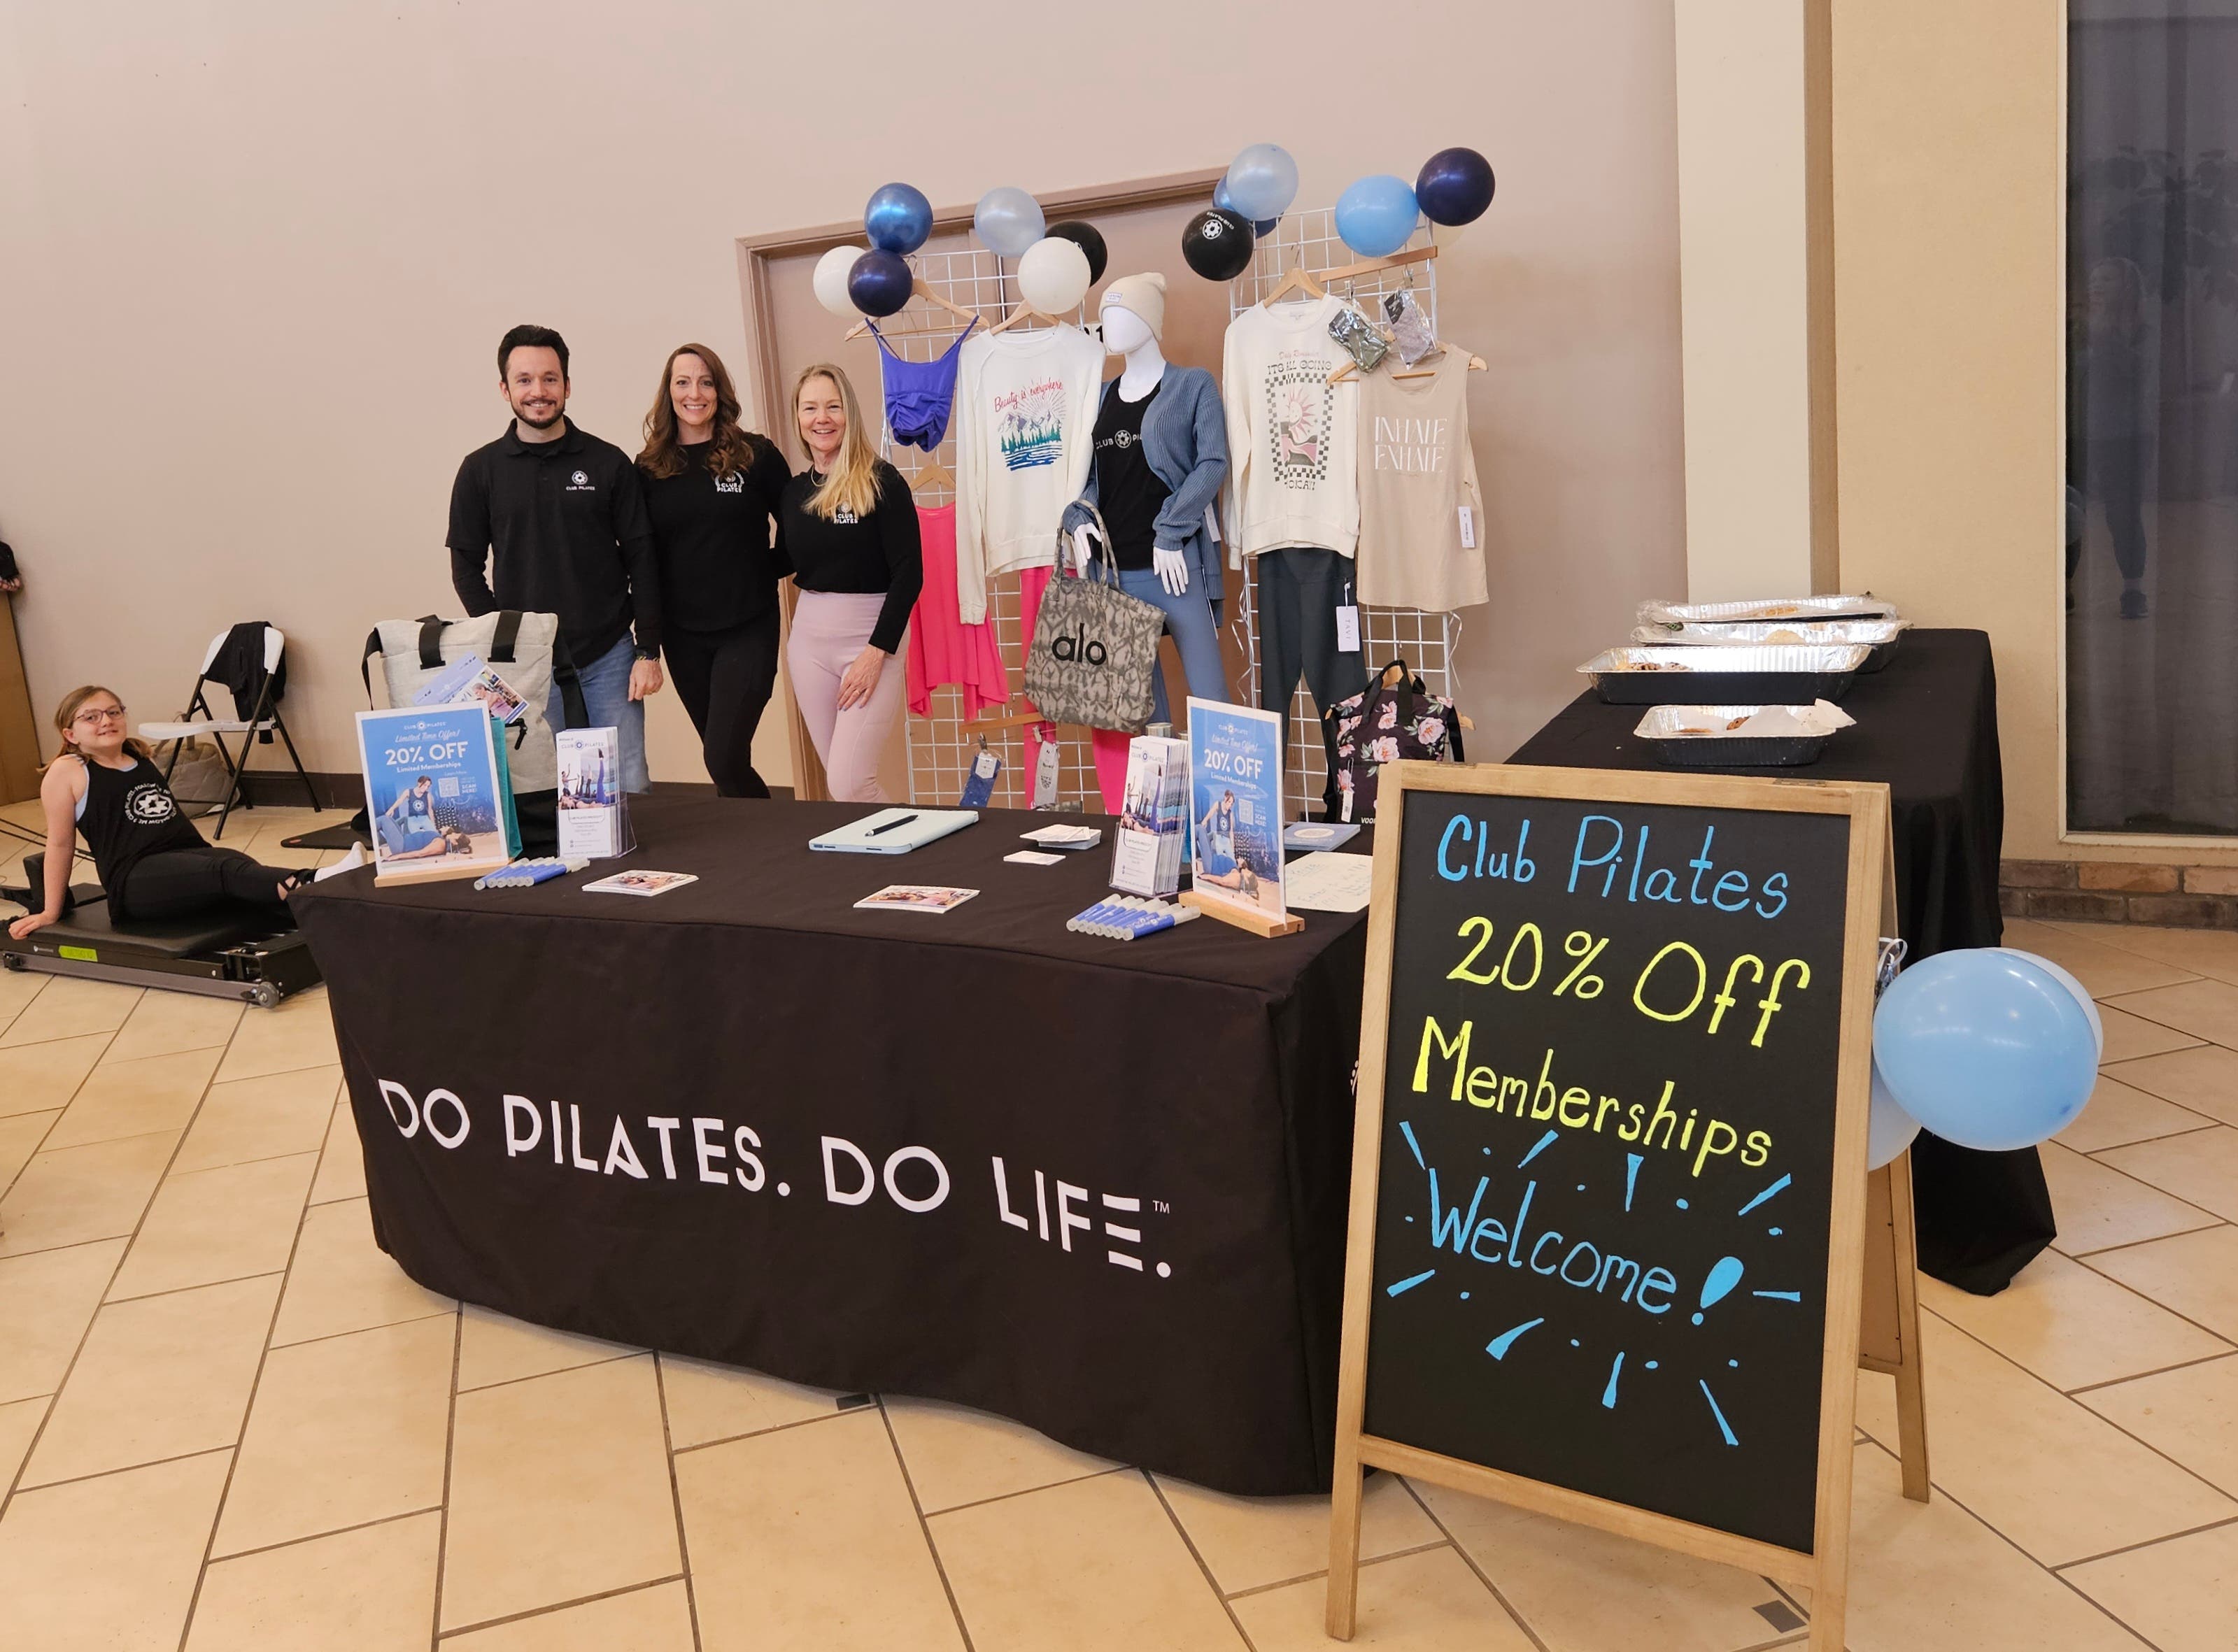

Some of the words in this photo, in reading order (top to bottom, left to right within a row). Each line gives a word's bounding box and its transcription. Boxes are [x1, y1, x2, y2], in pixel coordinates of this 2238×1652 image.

[1300, 359, 1332, 371] GOING
[994, 392, 1018, 413] Beauty
[1021, 390, 1026, 399] is
[1051, 622, 1107, 666] alo
[395, 733, 420, 743] Limited
[438, 729, 461, 741] Offer!
[385, 746, 424, 766] 20%
[429, 741, 469, 761] OFF
[421, 761, 462, 771] Memberships
[1204, 748, 1231, 773] 20%
[1233, 755, 1263, 780] OFF
[1436, 814, 1536, 883] Club
[1567, 815, 1789, 919] Pilates
[1446, 916, 1610, 1000] 20%
[1634, 941, 1811, 1048] Off
[1412, 1016, 1773, 1177] Memberships
[378, 1078, 470, 1149] DO
[503, 1094, 791, 1197] PILATES.
[821, 1135, 950, 1213] DO
[992, 1155, 1171, 1278] LIFE.
